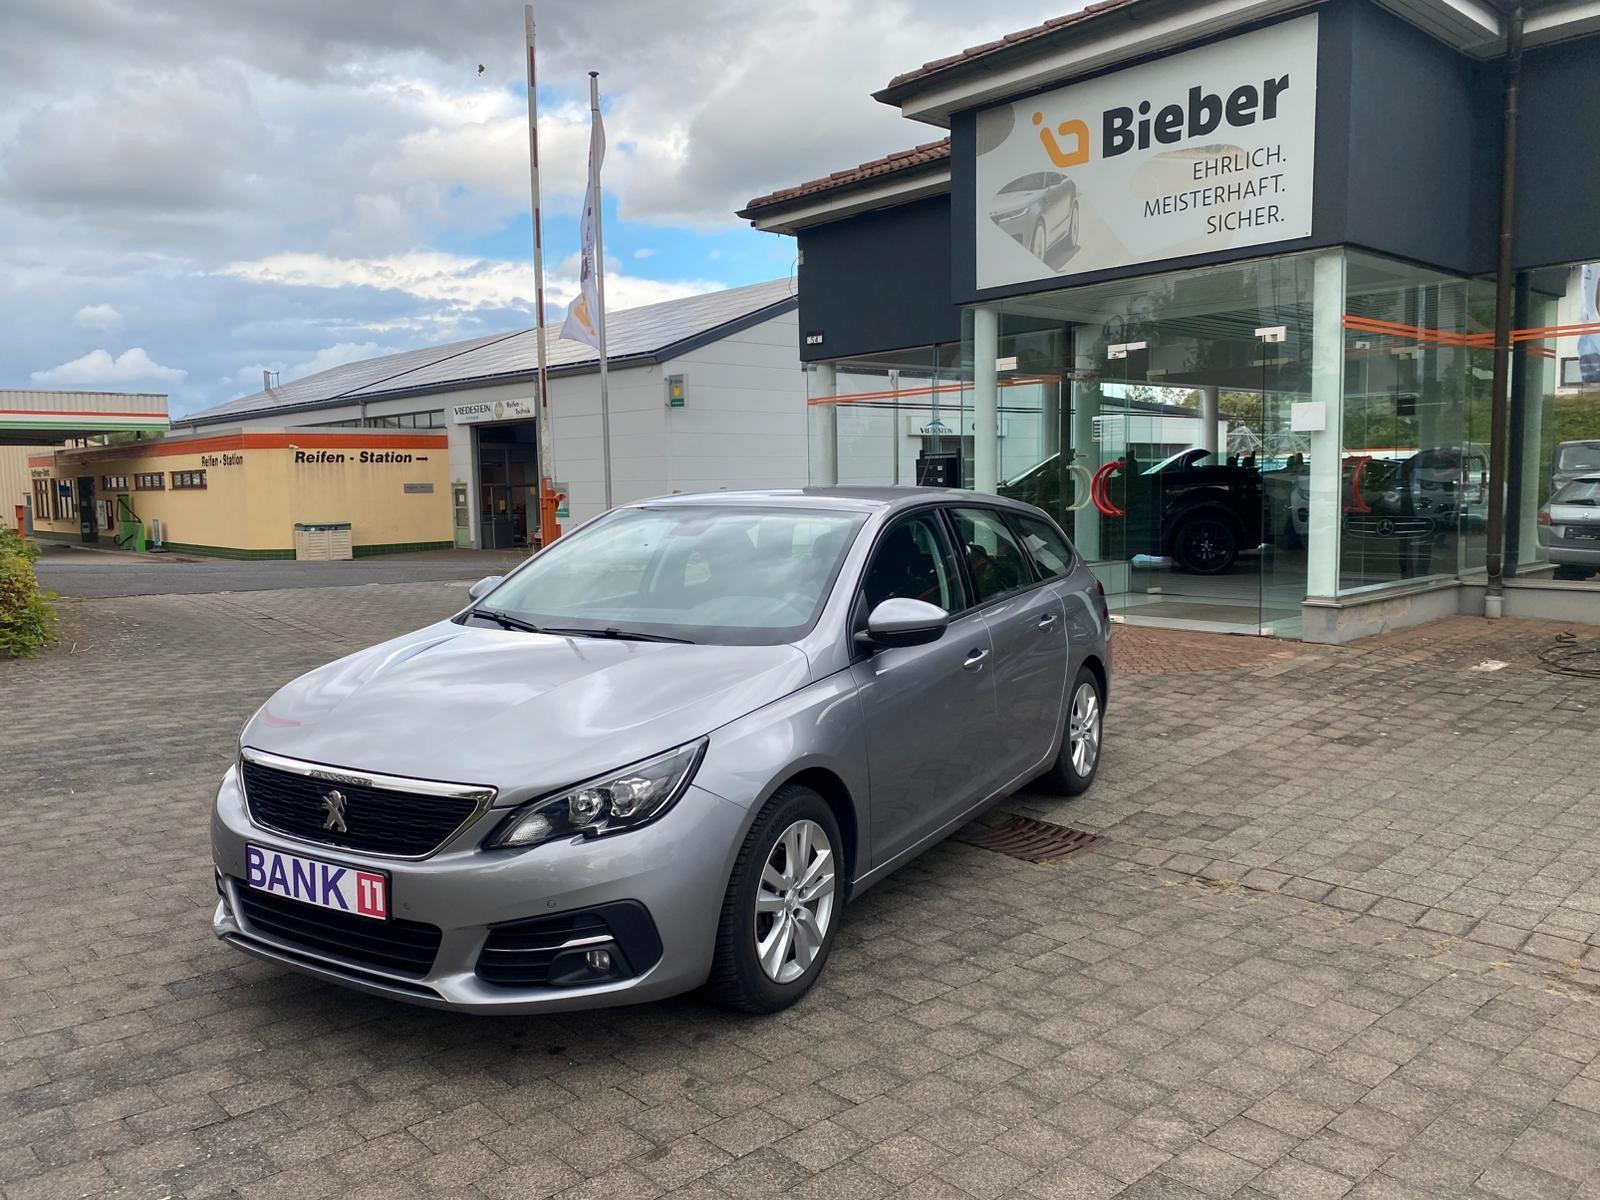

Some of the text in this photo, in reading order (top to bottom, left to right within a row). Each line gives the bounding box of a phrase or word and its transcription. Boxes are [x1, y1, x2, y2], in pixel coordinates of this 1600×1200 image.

[1102, 74, 1289, 159] Bieber
[1193, 144, 1287, 181] EHRLICH.
[1143, 173, 1286, 218] MEISTERHAFT.
[1206, 204, 1285, 235] SICHER.
[454, 404, 491, 416] VREDESTEIN
[201, 455, 219, 468] Reifen
[222, 453, 244, 467] Station
[294, 451, 345, 463] Reifen
[359, 451, 412, 463] Station
[246, 847, 384, 912] BANK 11
